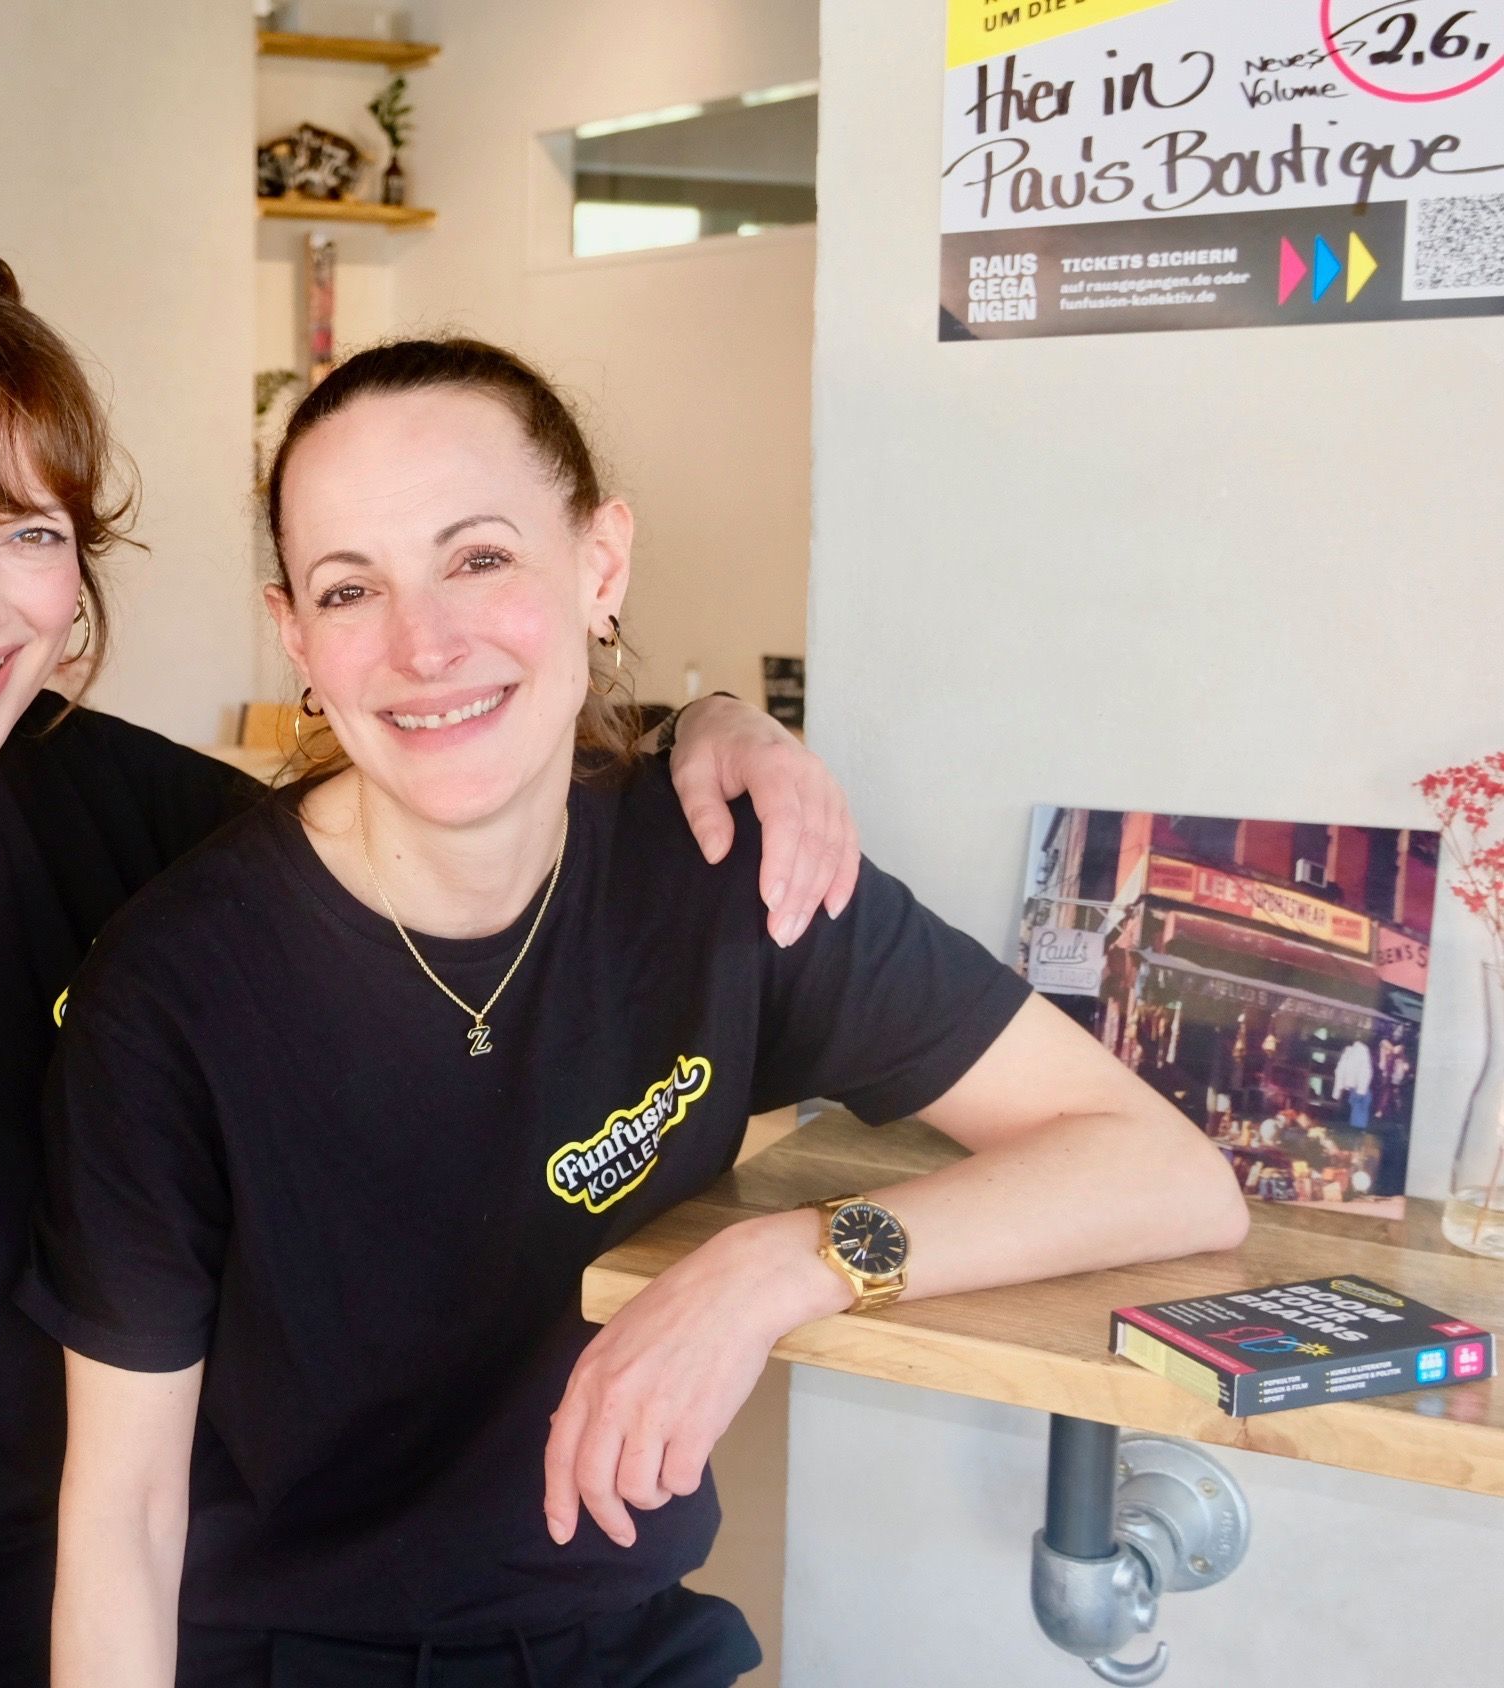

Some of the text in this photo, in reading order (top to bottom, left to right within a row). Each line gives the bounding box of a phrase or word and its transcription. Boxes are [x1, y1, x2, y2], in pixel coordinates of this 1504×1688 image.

[984, 0, 1067, 32] UM DIE
[1245, 48, 1326, 76] Neues
[965, 49, 1215, 134] Hier in
[1240, 78, 1348, 109] Volume
[1142, 122, 1504, 217] Boutique
[969, 253, 1038, 279] RAUS
[1061, 247, 1238, 273] TICKETS SICHERN
[968, 276, 1037, 301] GEGA
[1060, 271, 1251, 294] auf rausgegangen.de oder
[968, 299, 1037, 323] NGEN
[1060, 290, 1217, 310] funfusion-kollektiv.de
[467, 1025, 493, 1057] Z
[1226, 1294, 1369, 1342] BRAINS
[1260, 1289, 1360, 1323] YOUR
[1284, 1285, 1405, 1323] BOOM
